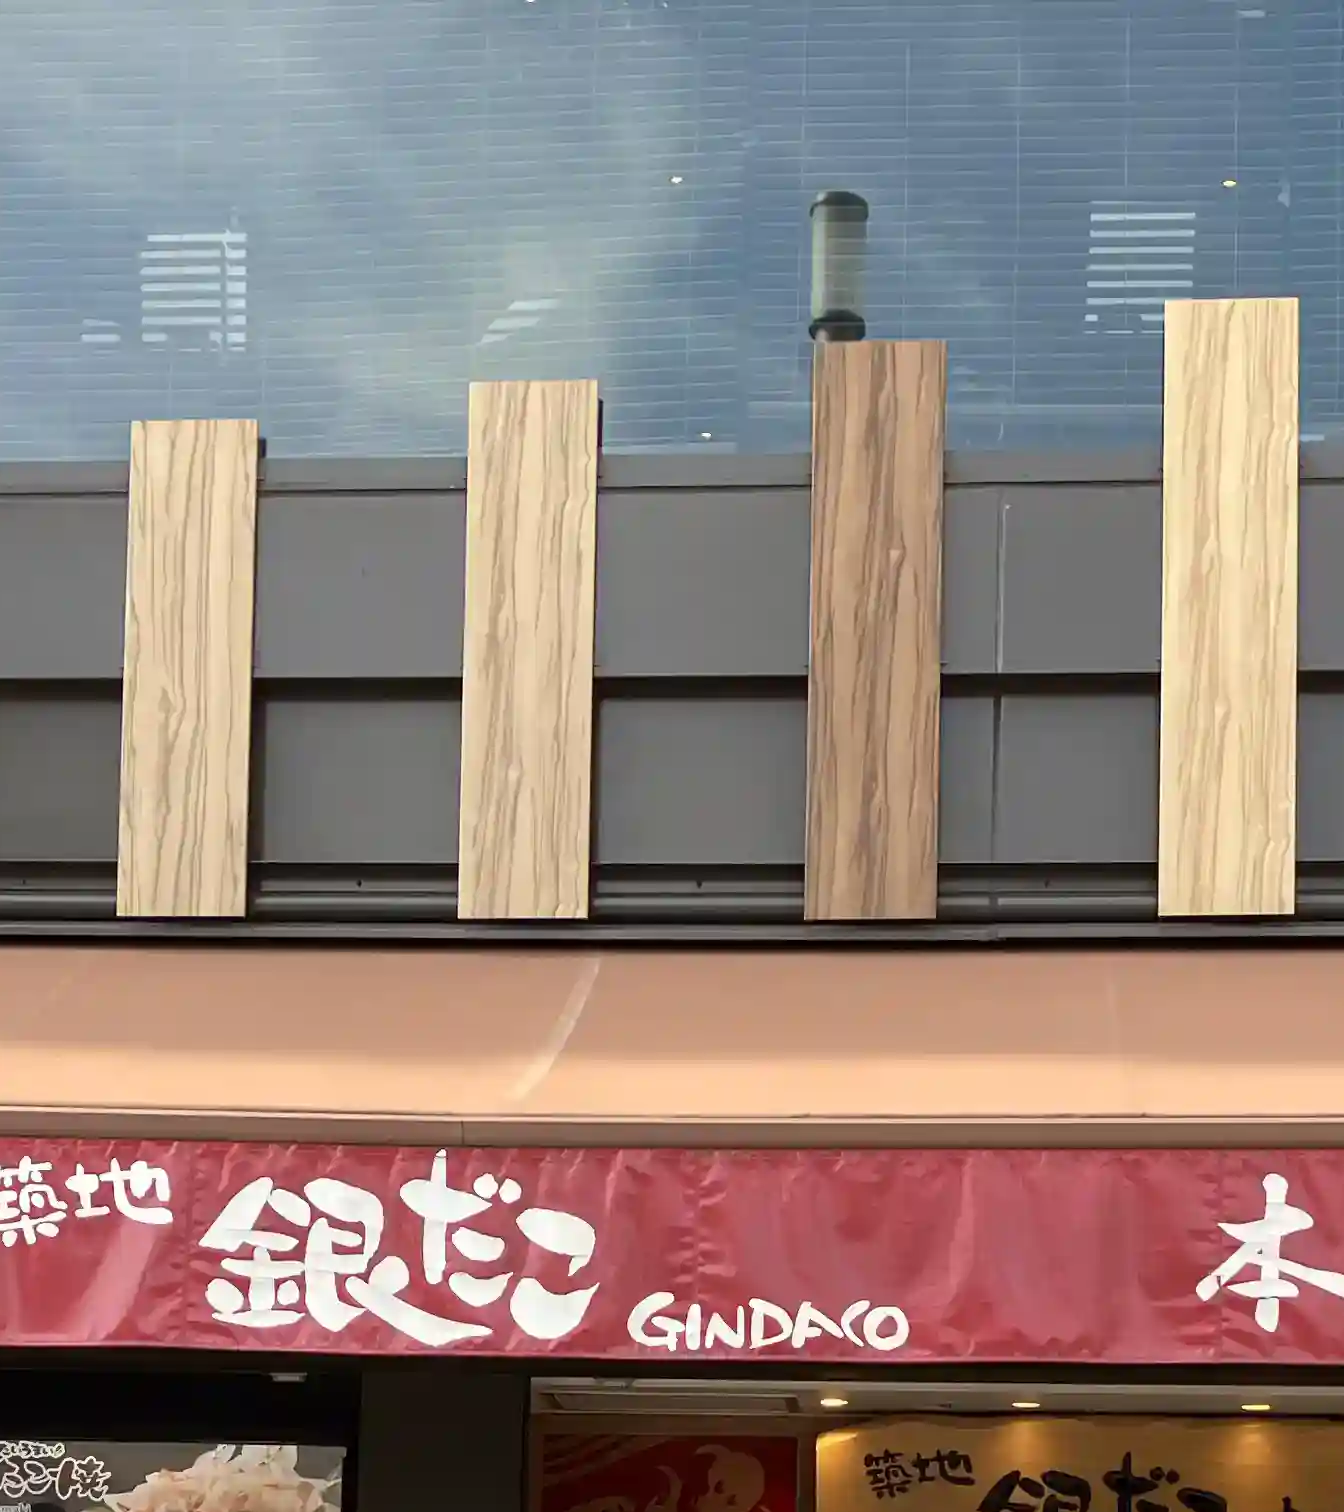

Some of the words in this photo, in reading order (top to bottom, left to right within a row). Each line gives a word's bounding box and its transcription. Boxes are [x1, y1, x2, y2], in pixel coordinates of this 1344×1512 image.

[199, 1148, 600, 1347] 銀だこ
[626, 1291, 910, 1352] GINDACO
[863, 1449, 975, 1499] 築地
